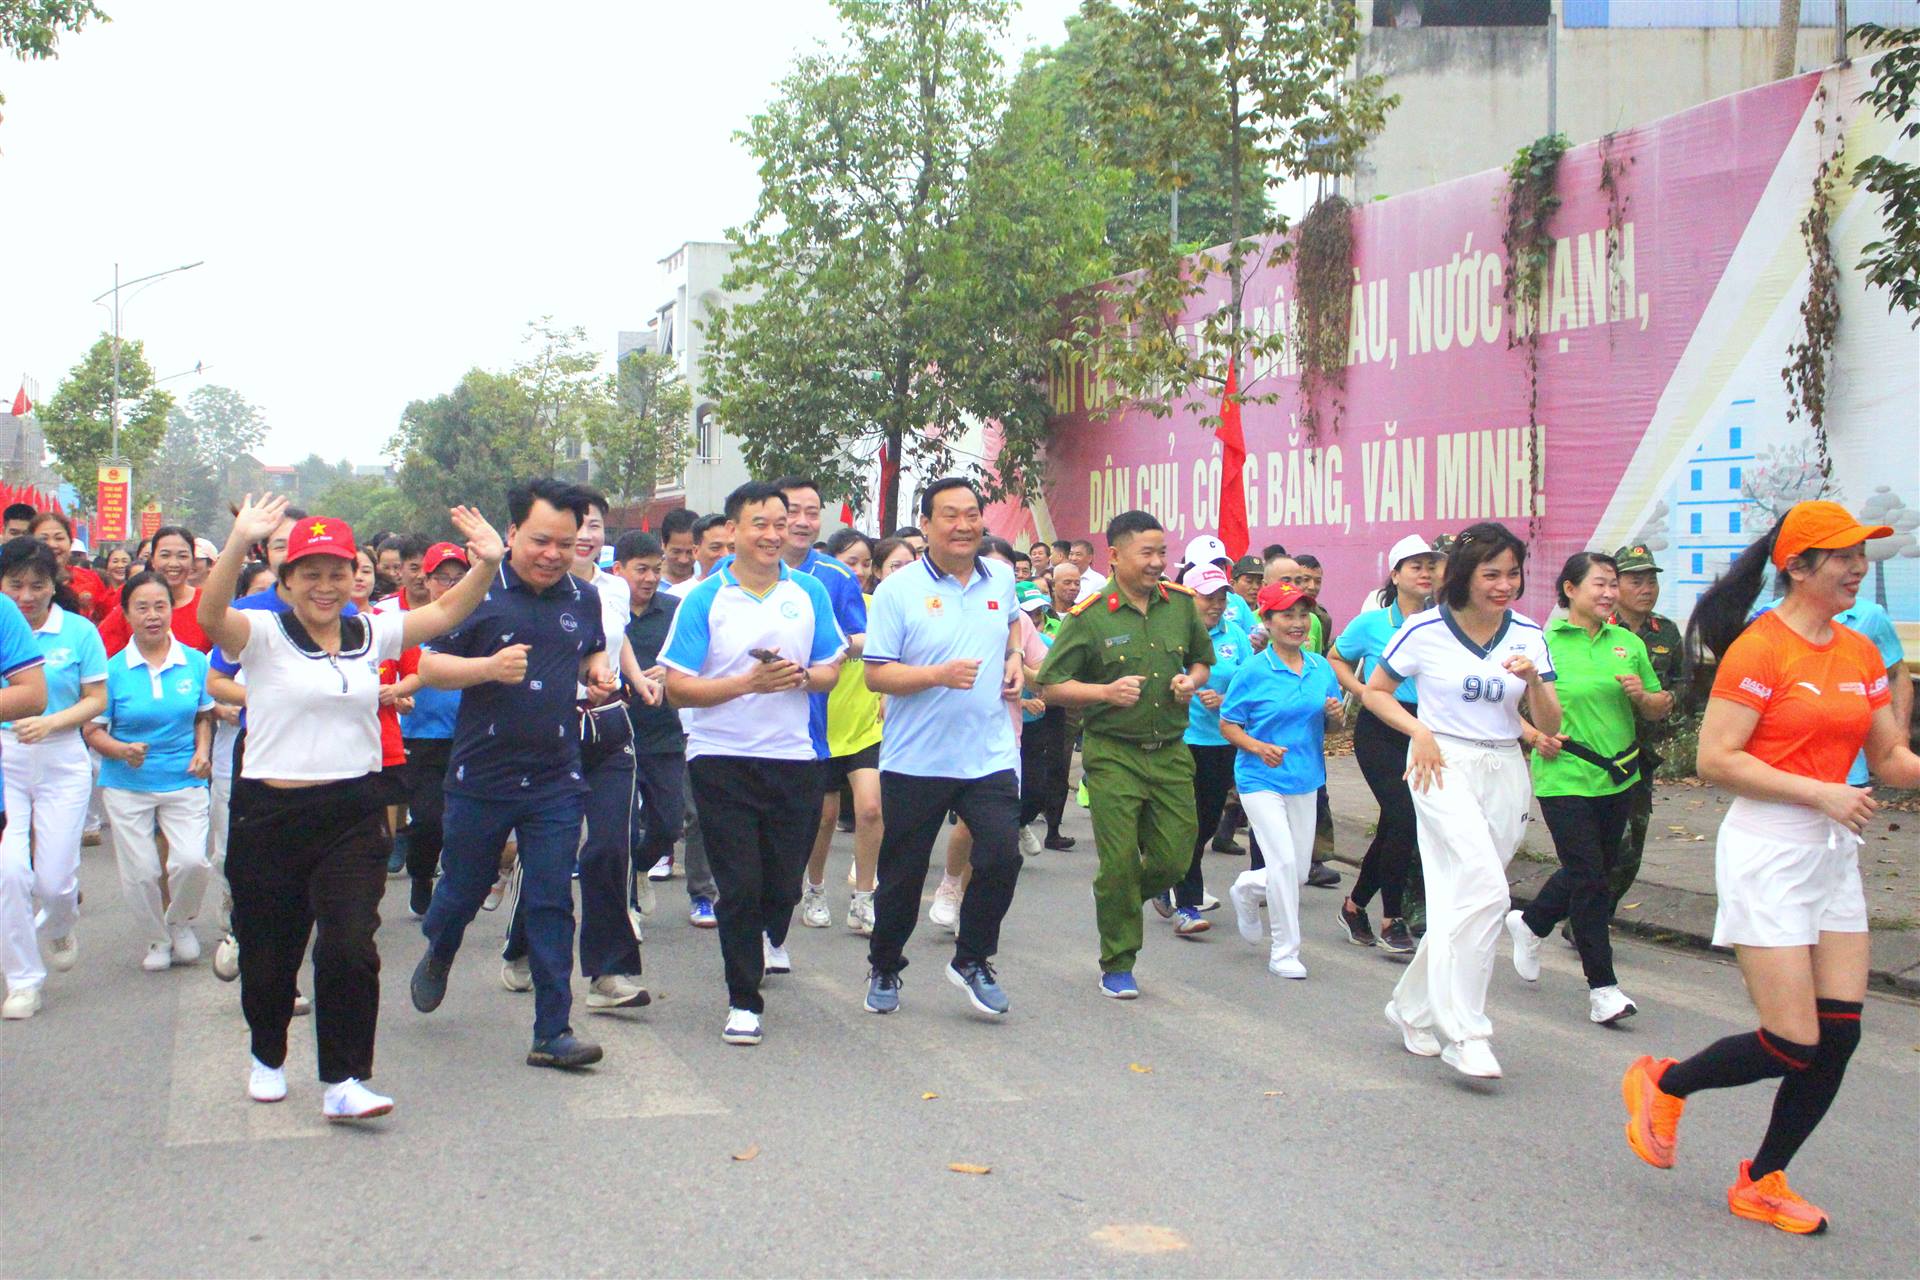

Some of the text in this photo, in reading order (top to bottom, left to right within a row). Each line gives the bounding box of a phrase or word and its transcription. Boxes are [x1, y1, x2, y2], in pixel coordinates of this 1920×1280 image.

[1326, 266, 1398, 371] ÀU,
[1409, 231, 1502, 355] NƯỚC
[1089, 412, 1547, 541] DÂN CHỦ, CÔG BẰNG, VĂN MINH!
[1461, 674, 1506, 704] 90
